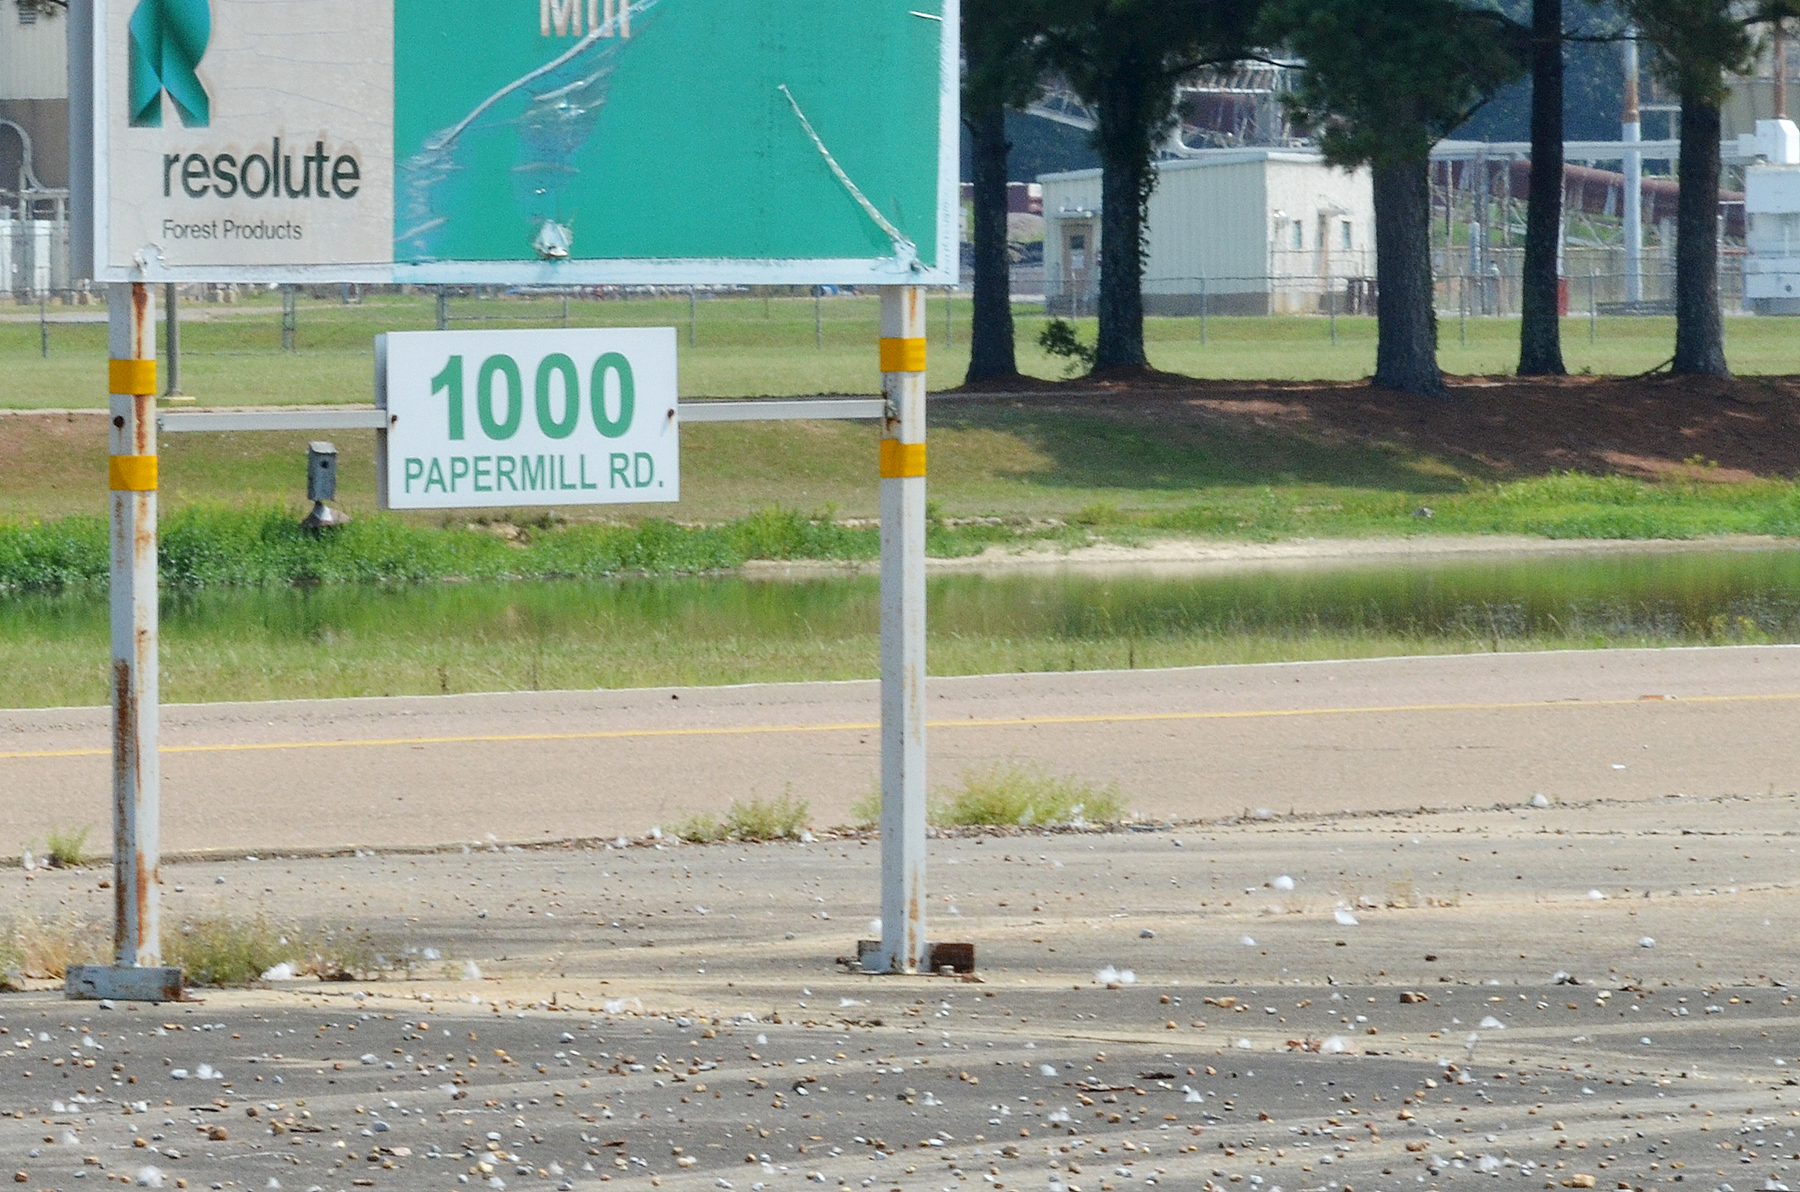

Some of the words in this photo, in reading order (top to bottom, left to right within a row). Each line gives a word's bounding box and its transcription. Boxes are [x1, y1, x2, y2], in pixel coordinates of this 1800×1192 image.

[163, 136, 360, 199] resolute
[163, 219, 218, 240] Forest
[224, 219, 303, 240] Products
[430, 352, 635, 441] 1000
[404, 453, 598, 494] PAPERMILL
[609, 452, 664, 489] RD.
